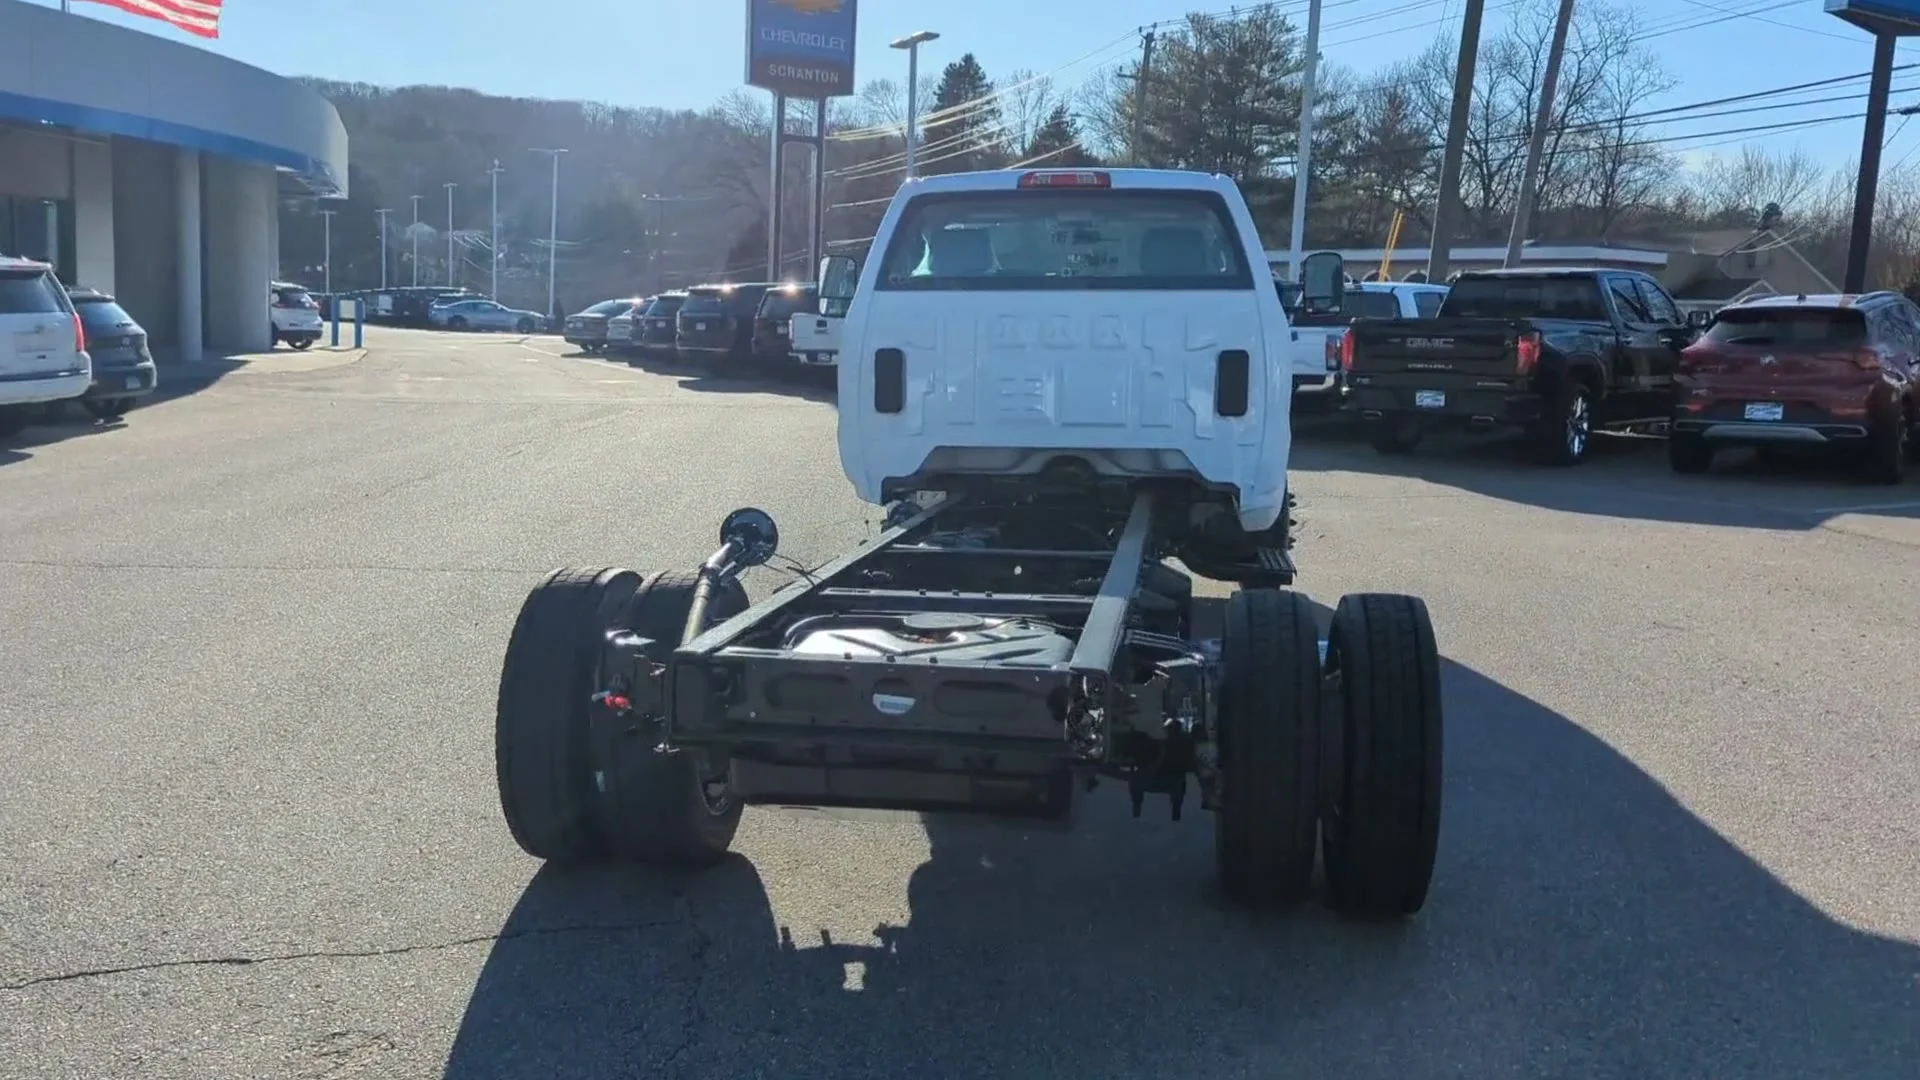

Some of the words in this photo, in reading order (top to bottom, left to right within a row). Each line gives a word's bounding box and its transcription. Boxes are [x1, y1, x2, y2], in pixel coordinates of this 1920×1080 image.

[761, 27, 846, 51] CHEVROLET
[768, 63, 839, 83] SCRANTON
[1406, 337, 1455, 348] GMC
